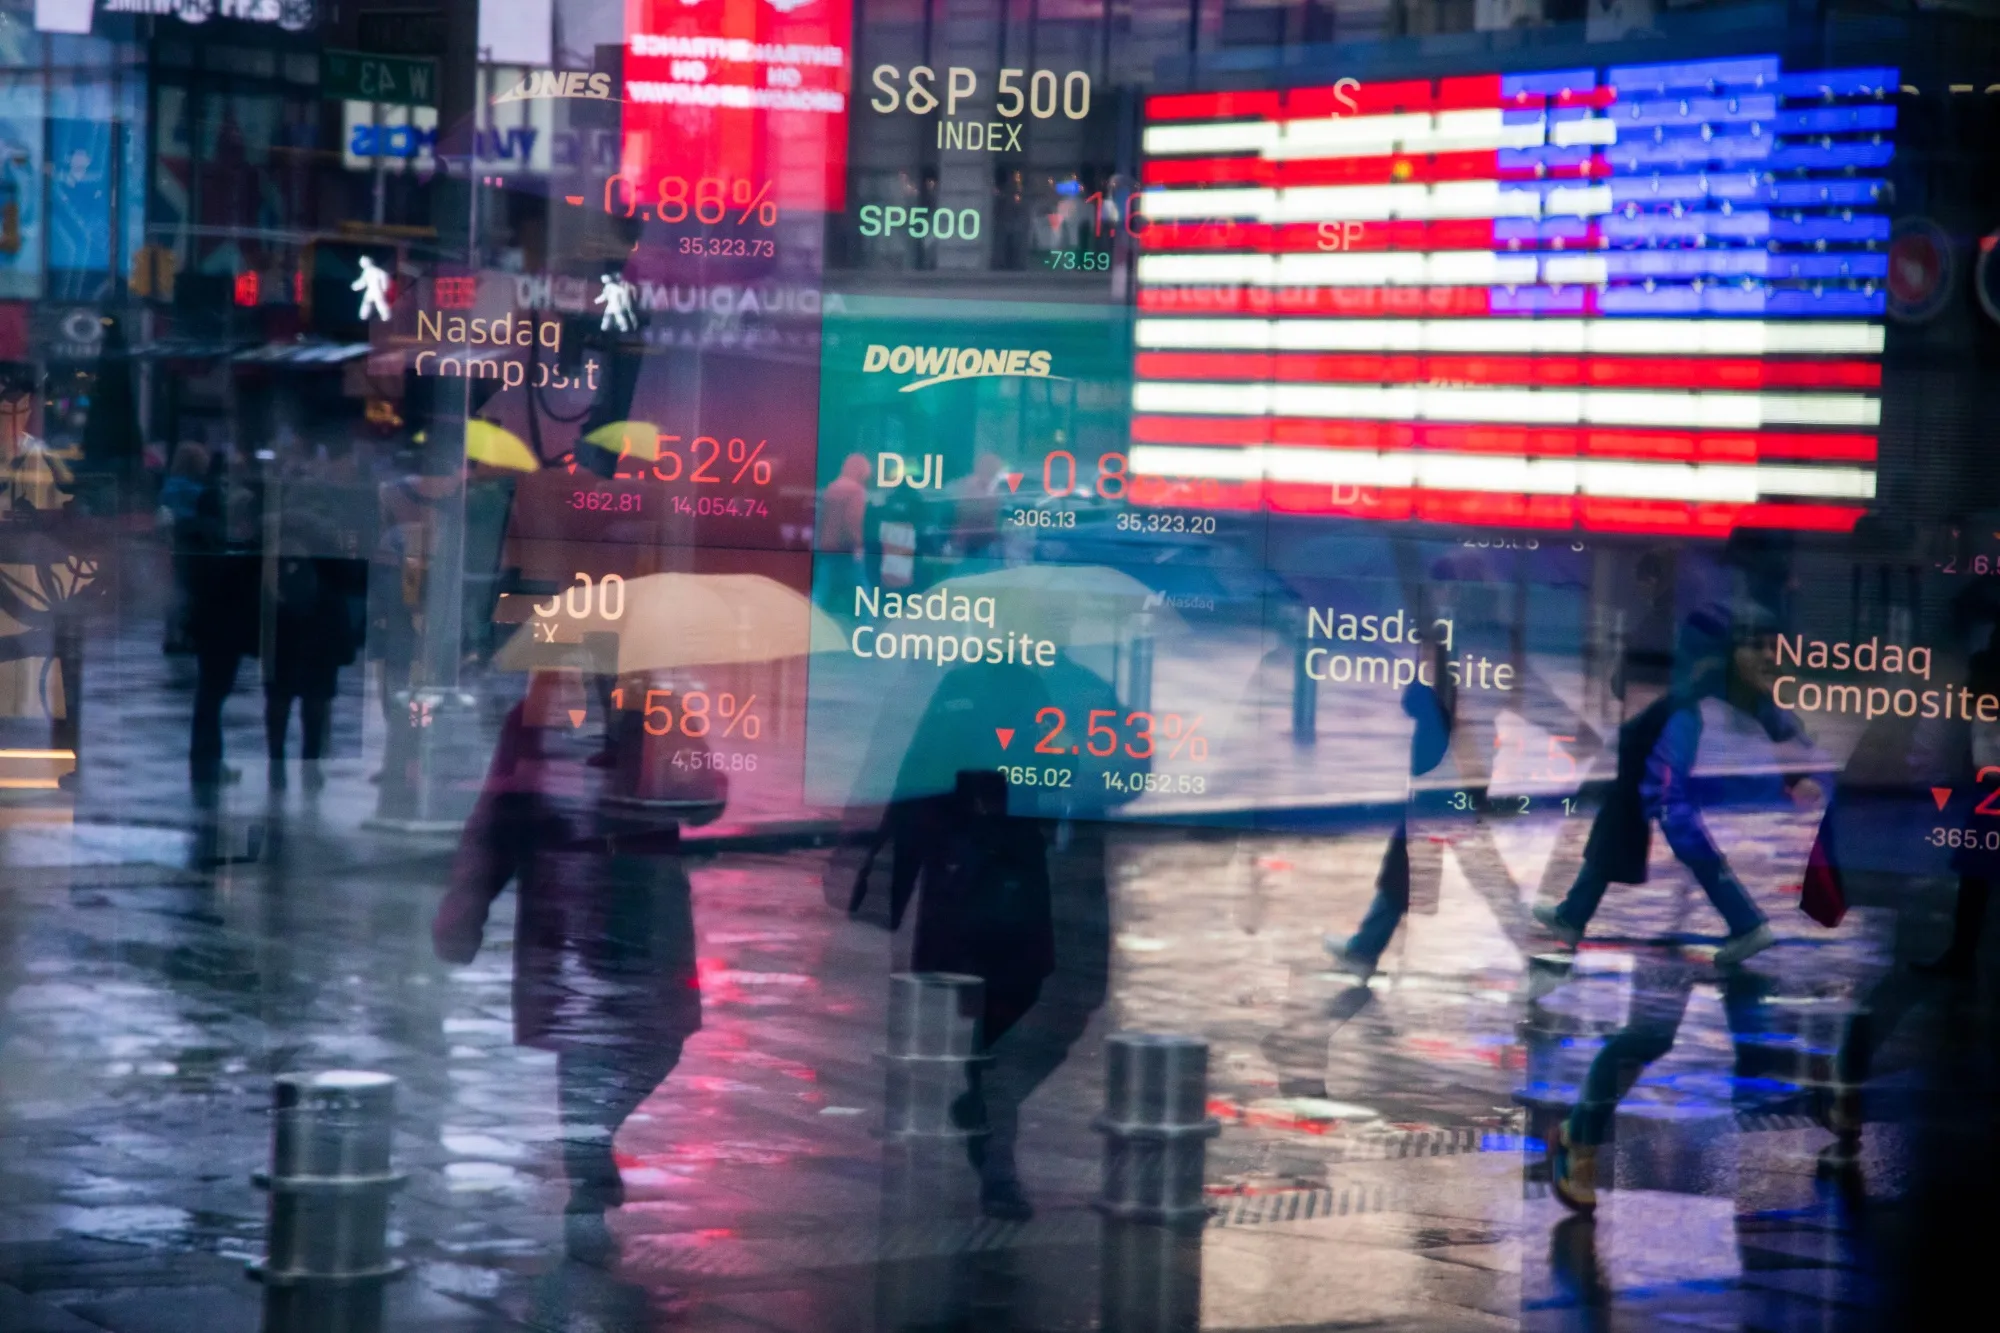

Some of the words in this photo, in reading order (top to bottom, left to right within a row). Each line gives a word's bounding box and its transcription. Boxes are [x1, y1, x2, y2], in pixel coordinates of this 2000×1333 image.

[511, 71, 611, 98] ONES
[870, 64, 977, 116] S&P
[996, 68, 1092, 120] 500
[937, 120, 1023, 152] INDEX
[604, 173, 777, 227] 0.86%
[858, 205, 981, 240] SP500
[679, 237, 775, 258] 35,323.73
[1044, 250, 1110, 271] -73.59
[417, 310, 561, 353] Nasdaq
[415, 351, 600, 392] Compost
[862, 344, 1053, 381] DOWJONES
[876, 452, 944, 490] DJI
[565, 491, 642, 512] -362.81
[671, 495, 769, 519] 14,054.74
[1007, 509, 1077, 529] -306.13
[1116, 513, 1217, 535] 35,323.20
[853, 585, 996, 629] Nasdaq
[1166, 595, 1214, 612] Nasdaq
[851, 626, 1057, 667] Composite
[1775, 633, 1932, 681] Nasdaq
[1772, 675, 1999, 722] Composite
[1033, 706, 1209, 762] 2.53%
[671, 750, 758, 773] 4,516.86
[1101, 771, 1207, 794] 14,052.53
[1924, 827, 2000, 851] -365.0
